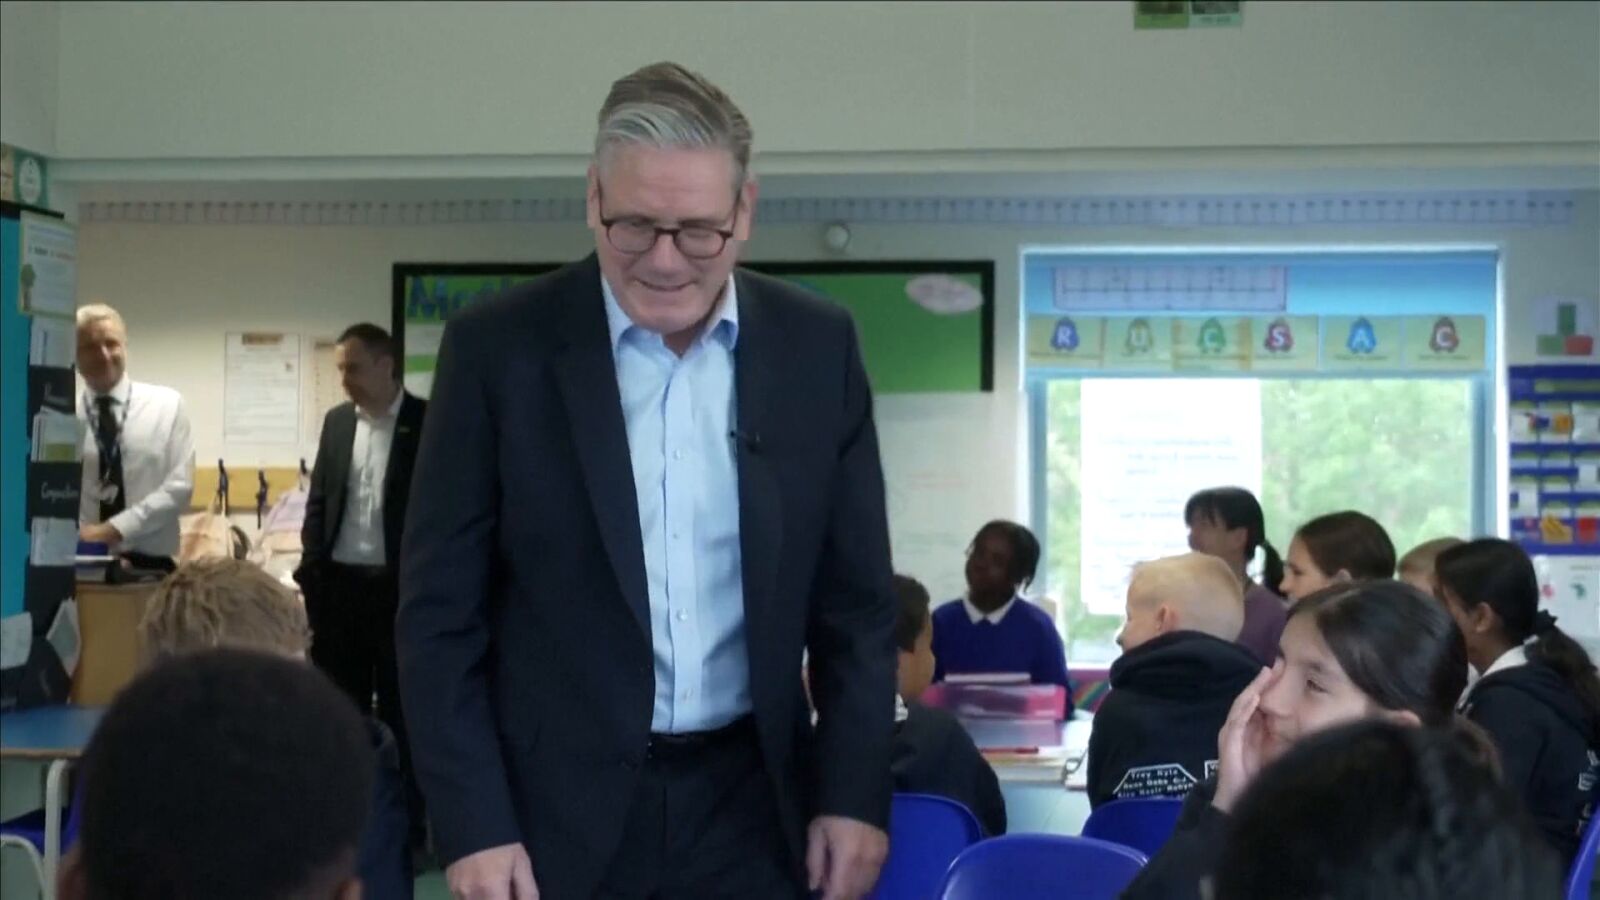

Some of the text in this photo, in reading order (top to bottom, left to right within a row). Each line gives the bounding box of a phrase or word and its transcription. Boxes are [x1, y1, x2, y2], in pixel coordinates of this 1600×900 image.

[1057, 325, 1453, 349] R U C S A C
